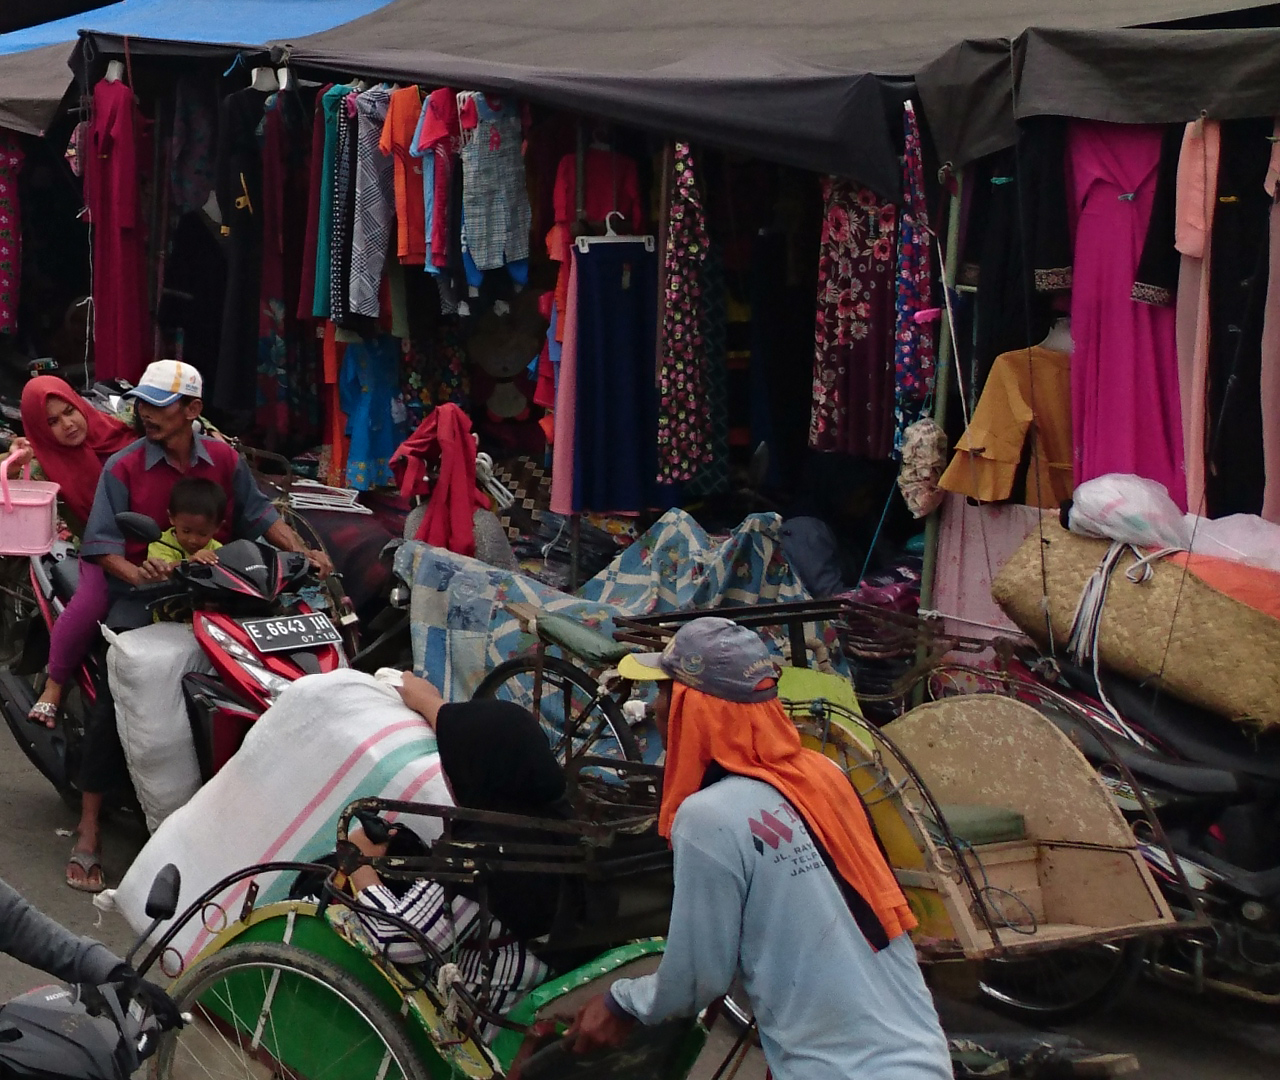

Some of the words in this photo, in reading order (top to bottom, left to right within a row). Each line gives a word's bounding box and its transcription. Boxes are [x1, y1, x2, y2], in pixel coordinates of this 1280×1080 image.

[247, 624, 262, 638] E
[266, 619, 306, 636] 6643
[794, 842, 813, 855] RAY
